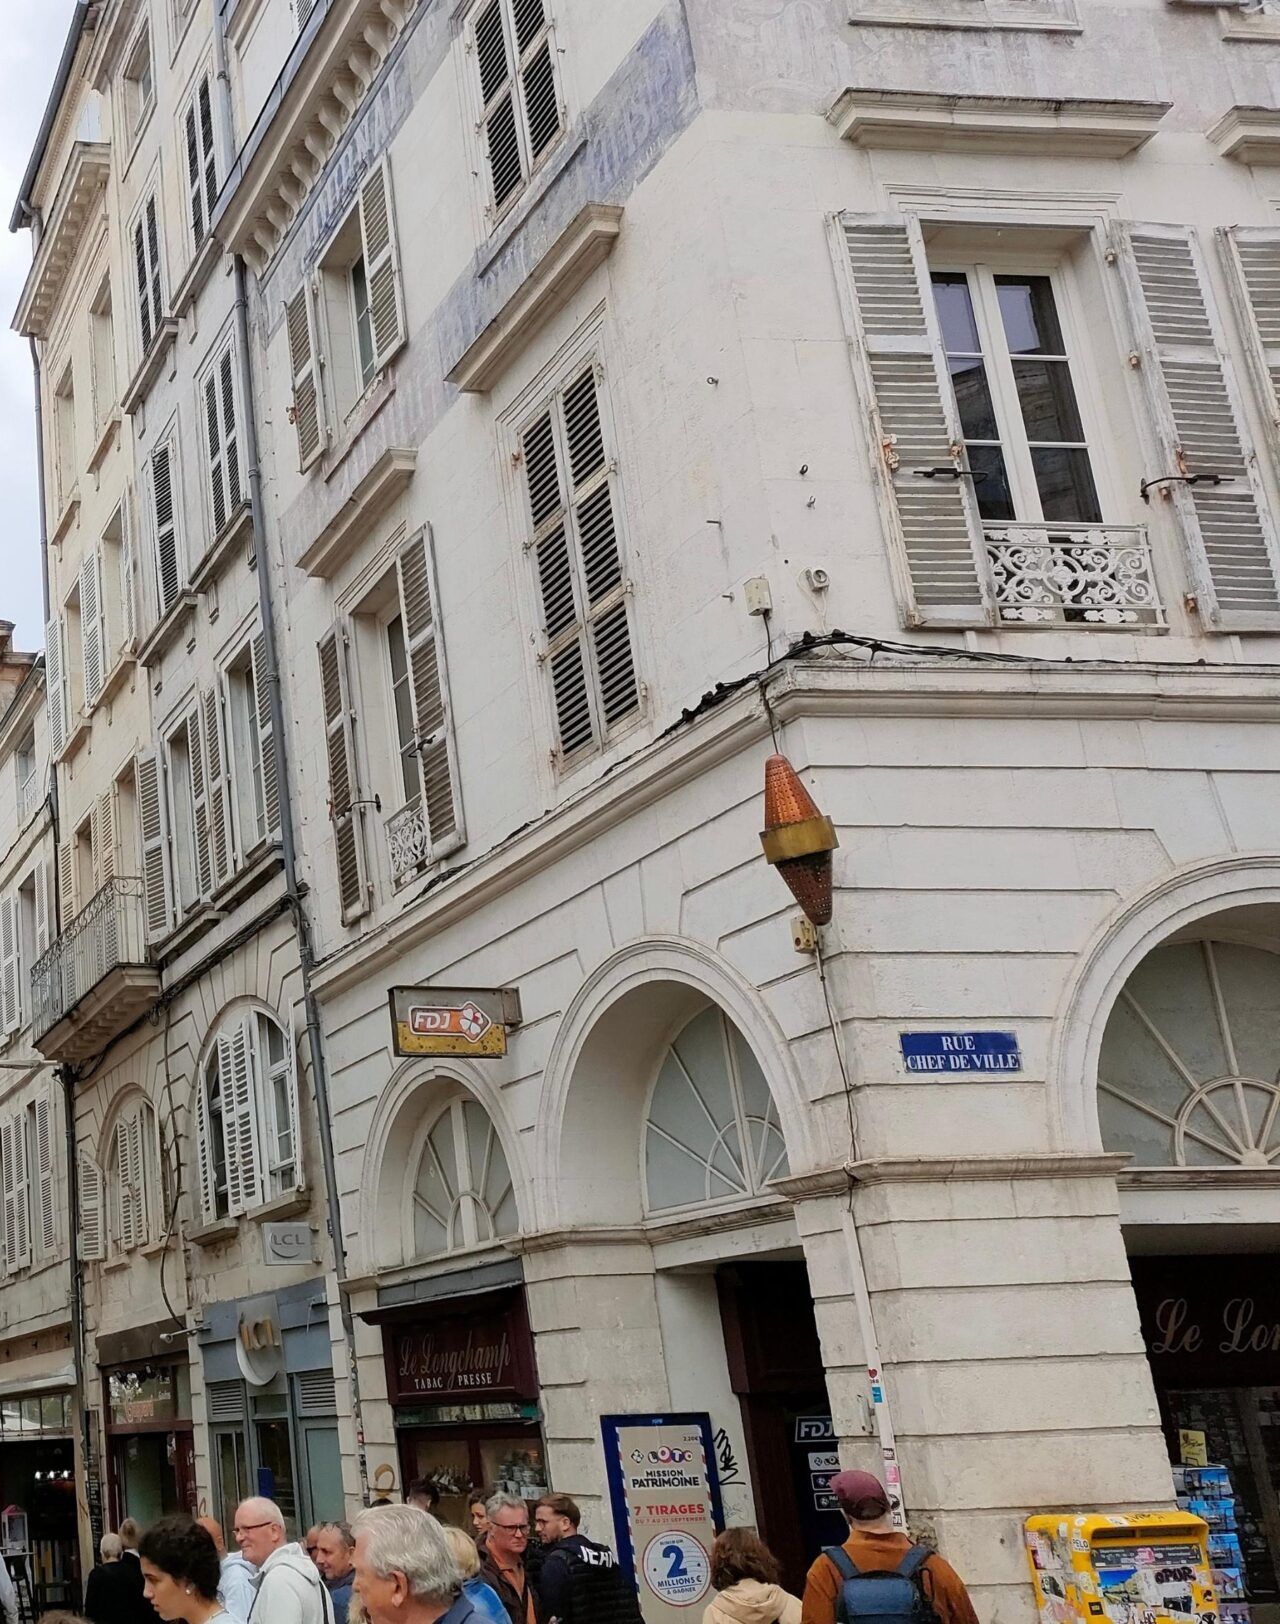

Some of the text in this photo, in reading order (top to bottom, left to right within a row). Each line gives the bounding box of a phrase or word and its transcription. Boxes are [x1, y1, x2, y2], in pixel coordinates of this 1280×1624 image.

[414, 1011, 451, 1029] FDJ
[941, 1035, 976, 1051] RUE
[906, 1053, 1019, 1070] CHEF DE VILLE
[273, 1233, 305, 1246] LCL
[1152, 1298, 1204, 1353] Le
[239, 1318, 280, 1351] LCL
[399, 1329, 511, 1391] Le Longchamp
[414, 1372, 493, 1390] TABAC PRESSE
[800, 1421, 834, 1437] FDJ
[648, 1446, 694, 1464] LOTO
[631, 1476, 700, 1488] PATRIMOINE
[645, 1469, 684, 1478] MISSION
[634, 1503, 705, 1516] 7 TIRAGES
[662, 1545, 688, 1578] 2
[657, 1576, 696, 1588] MILLIONS
